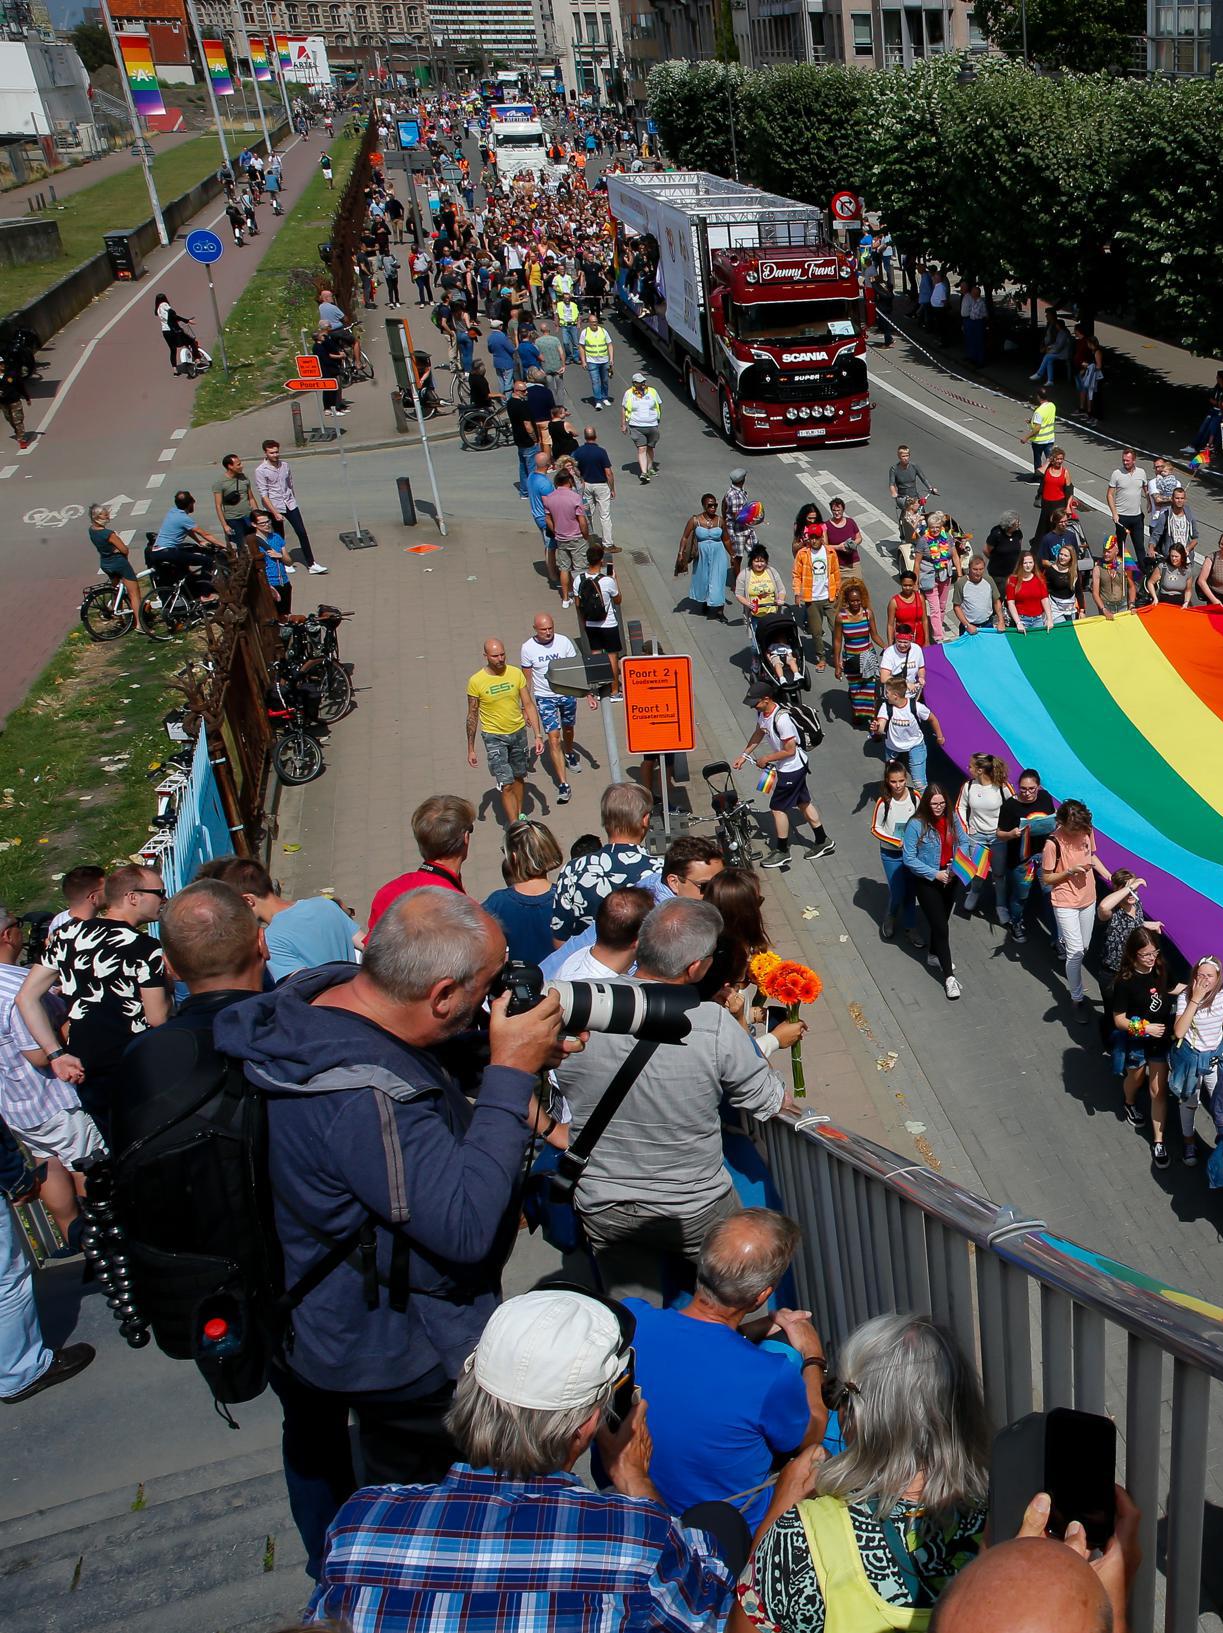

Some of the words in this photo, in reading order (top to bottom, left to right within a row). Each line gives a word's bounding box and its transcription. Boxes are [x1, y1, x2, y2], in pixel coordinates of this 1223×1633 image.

[762, 262, 807, 280] Danny
[804, 259, 836, 279] Trans
[781, 351, 829, 363] SCANIA
[628, 669, 657, 679] Poort
[663, 668, 670, 677] 2
[631, 704, 660, 714] Poort
